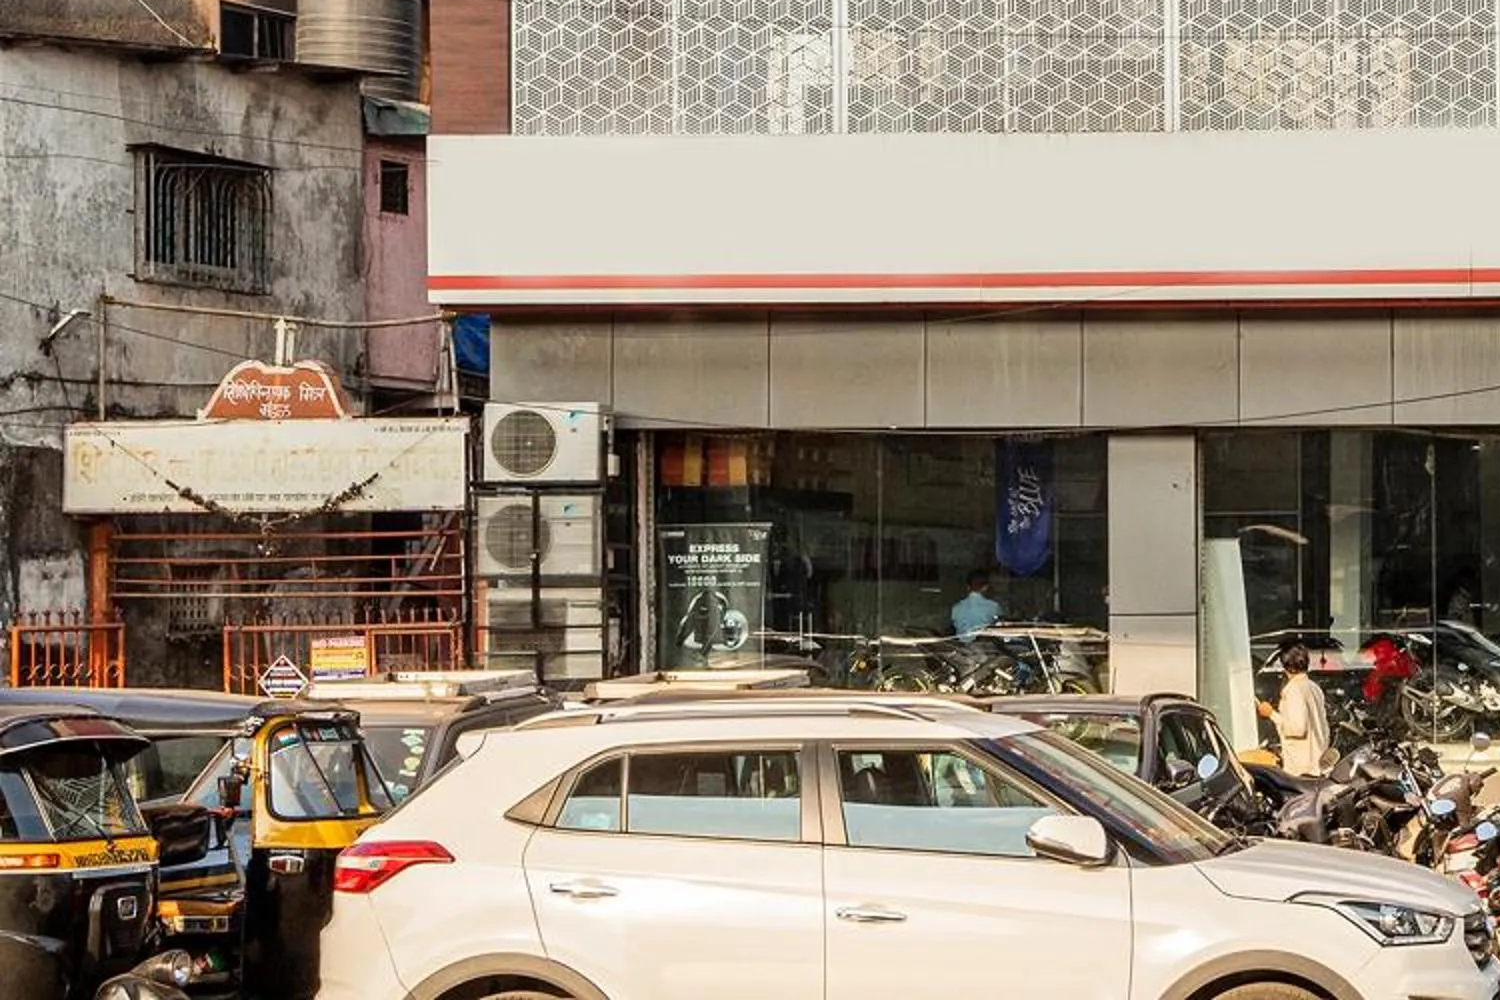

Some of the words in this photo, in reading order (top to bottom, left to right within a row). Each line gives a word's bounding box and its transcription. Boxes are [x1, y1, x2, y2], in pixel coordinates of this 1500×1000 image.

[689, 543, 740, 553] EXPRESS
[668, 555, 699, 565] YOUR
[701, 554, 733, 563] DARK
[734, 553, 761, 563] SIDE
